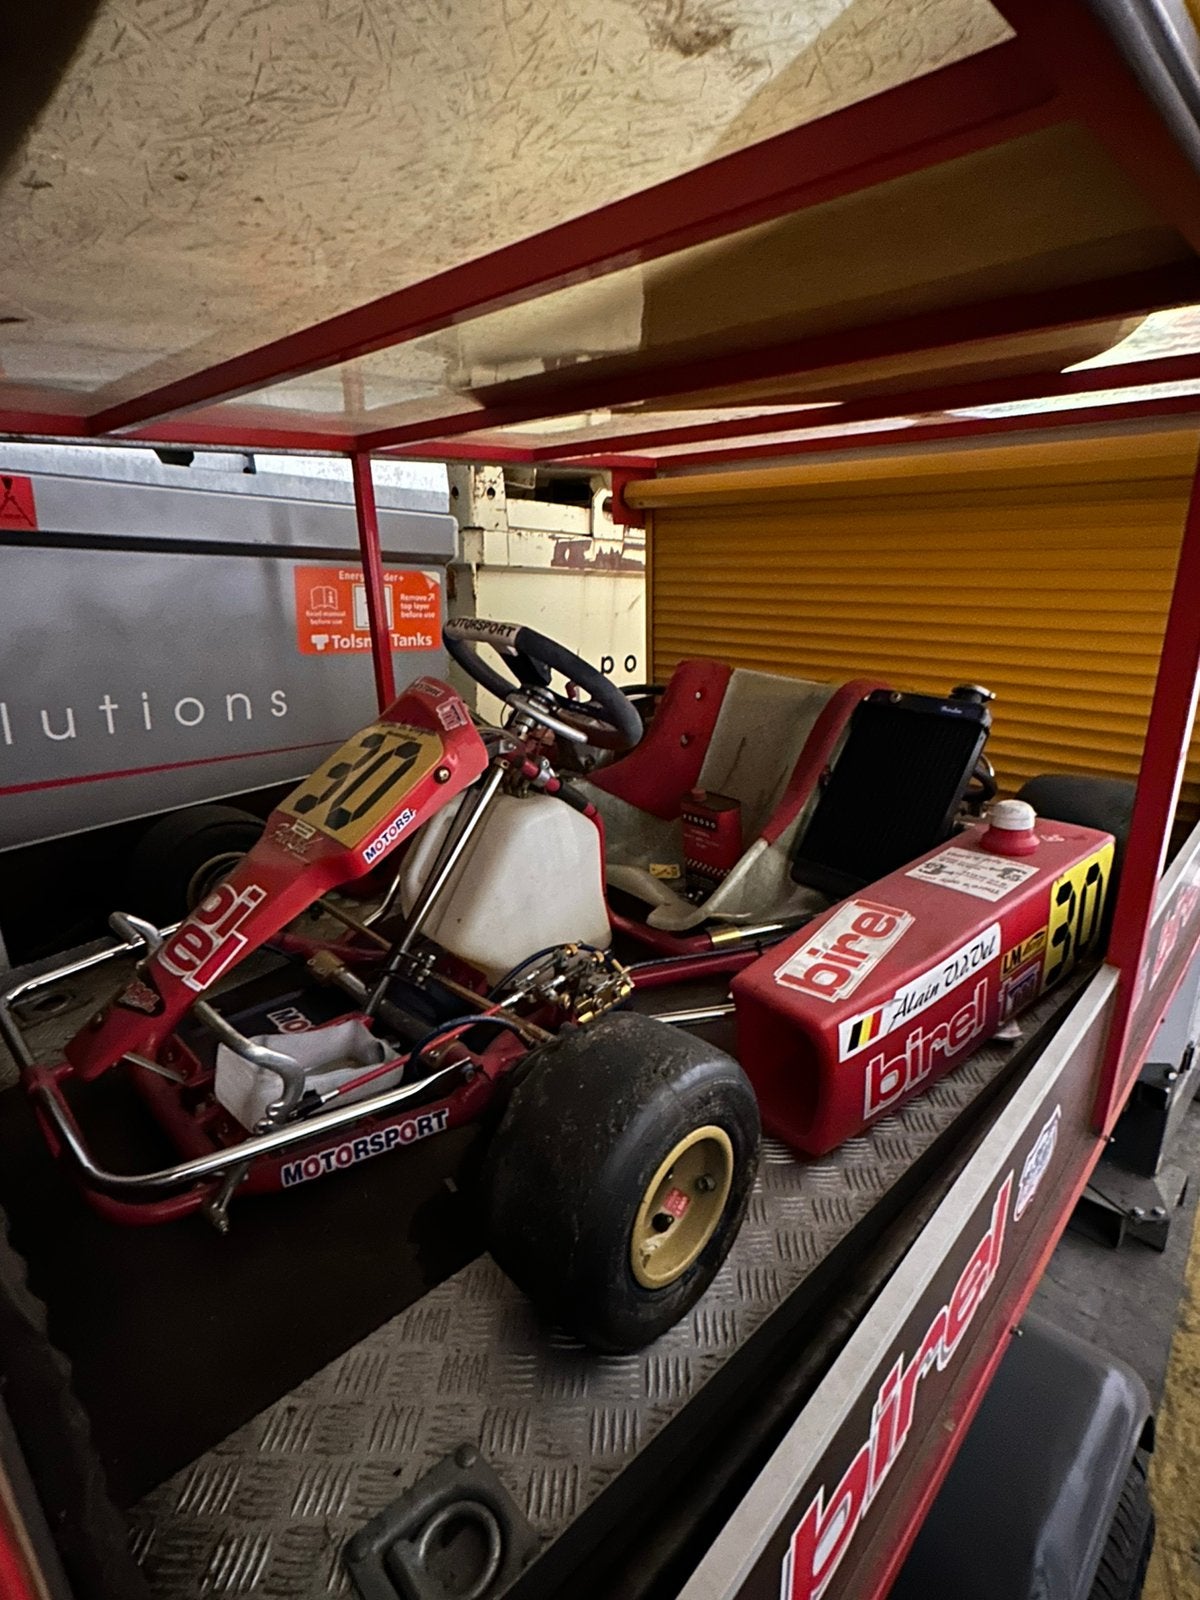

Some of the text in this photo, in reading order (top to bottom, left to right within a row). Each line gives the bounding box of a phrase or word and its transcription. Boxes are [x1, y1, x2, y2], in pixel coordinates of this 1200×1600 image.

[391, 632, 433, 648] Tanks
[400, 593, 428, 601] Remove
[294, 732, 423, 831] 30
[776, 899, 912, 1003] birel
[1045, 862, 1104, 987] 30
[864, 977, 988, 1120] birel
[887, 983, 940, 1034] Alain
[281, 1107, 450, 1189] MOTORSPORT
[782, 1169, 1015, 1600] birel
